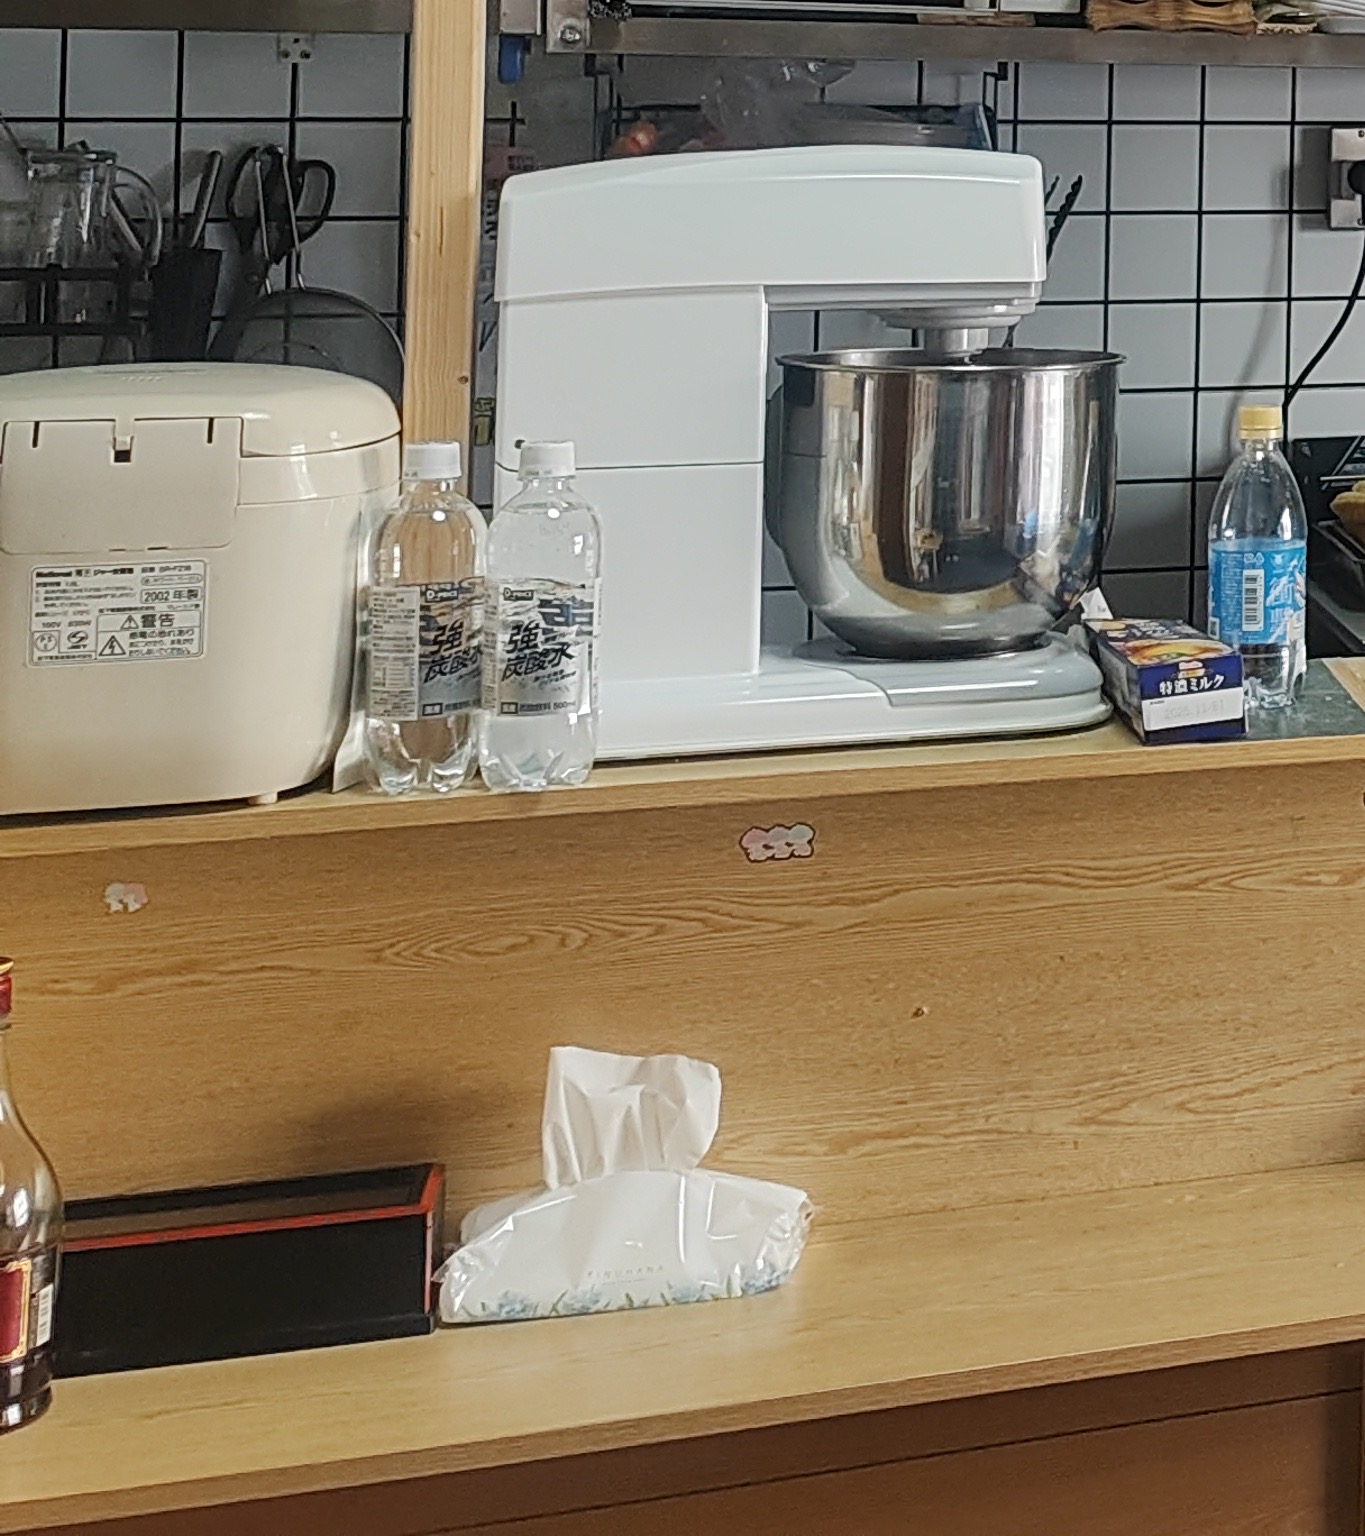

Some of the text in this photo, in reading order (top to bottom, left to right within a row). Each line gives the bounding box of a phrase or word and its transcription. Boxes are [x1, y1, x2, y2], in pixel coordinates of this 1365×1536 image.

[141, 613, 175, 628] 警告
[429, 618, 465, 655] 強
[505, 619, 541, 654] 強
[1158, 674, 1225, 696] 特濃ミルク
